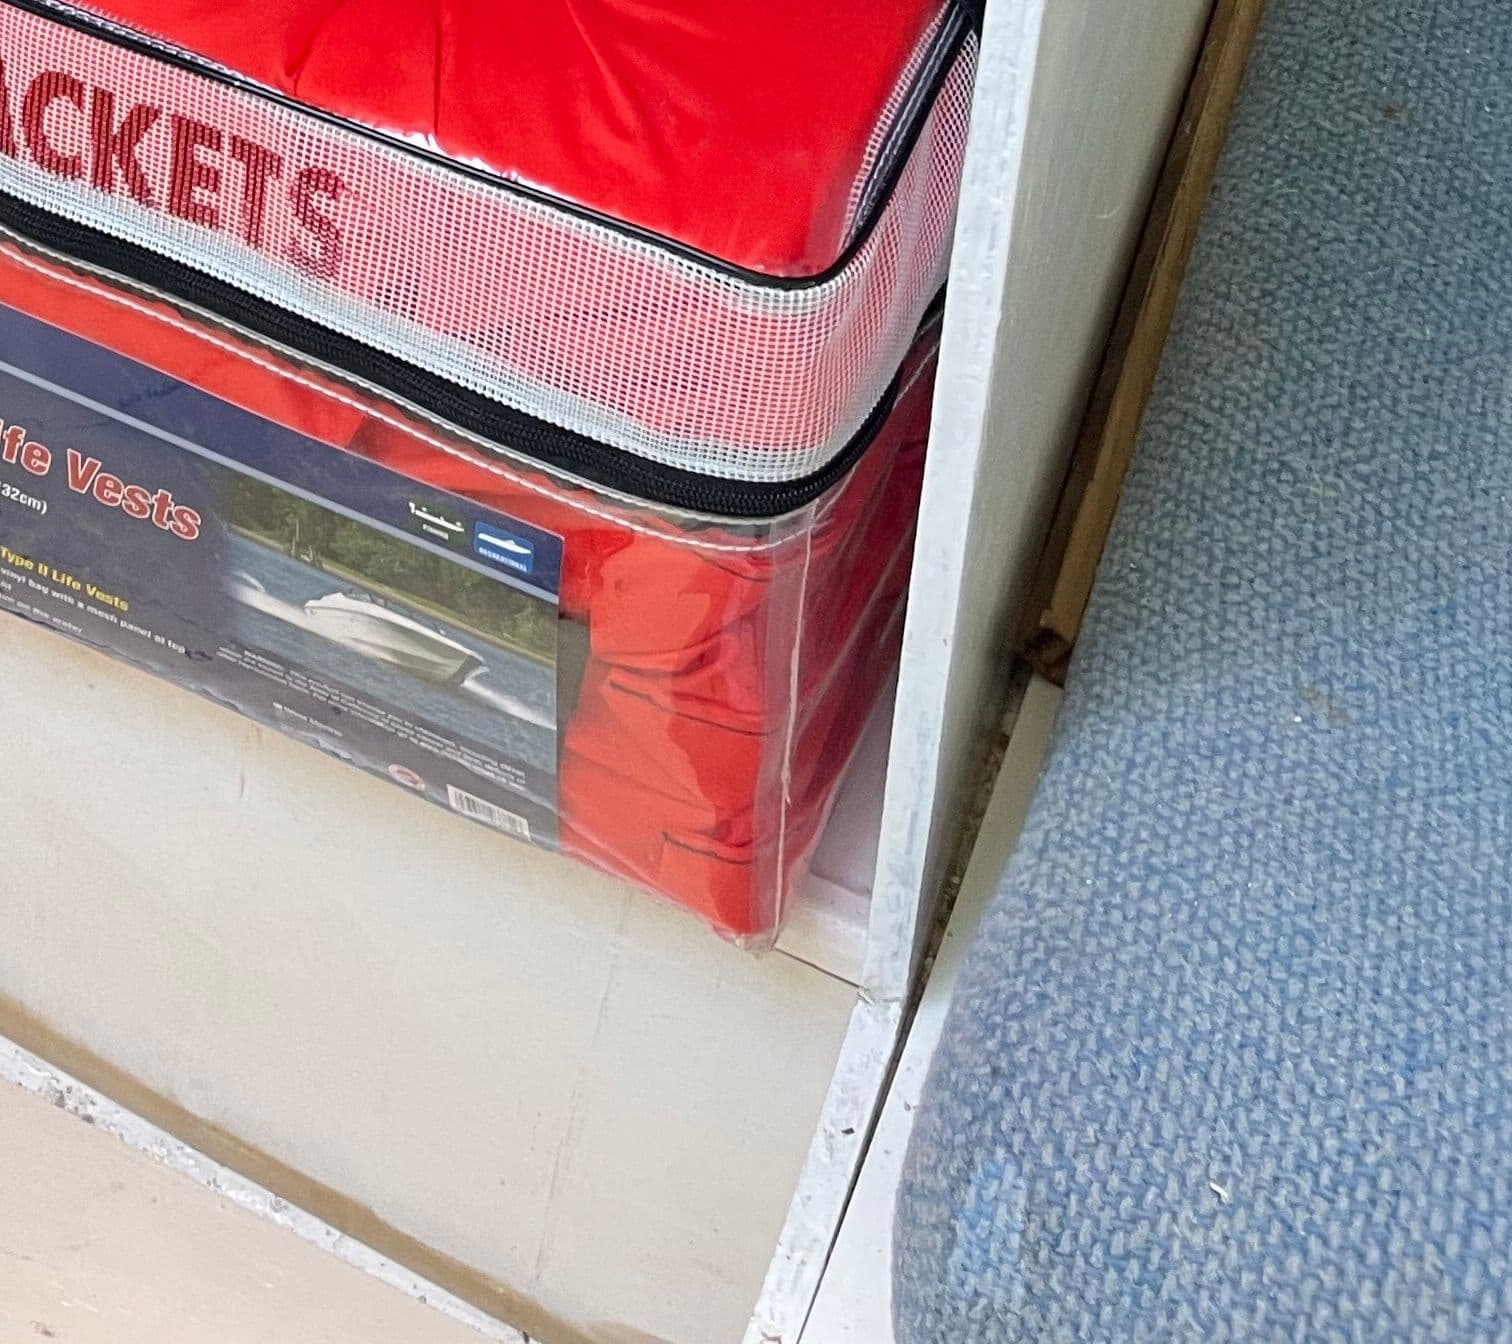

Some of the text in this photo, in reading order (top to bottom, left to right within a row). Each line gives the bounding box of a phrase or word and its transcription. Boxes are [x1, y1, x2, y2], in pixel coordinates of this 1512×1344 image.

[66, 448, 202, 542] Vests
[0, 545, 34, 571] Type
[51, 568, 81, 592] Life
[86, 583, 129, 612] Vests
